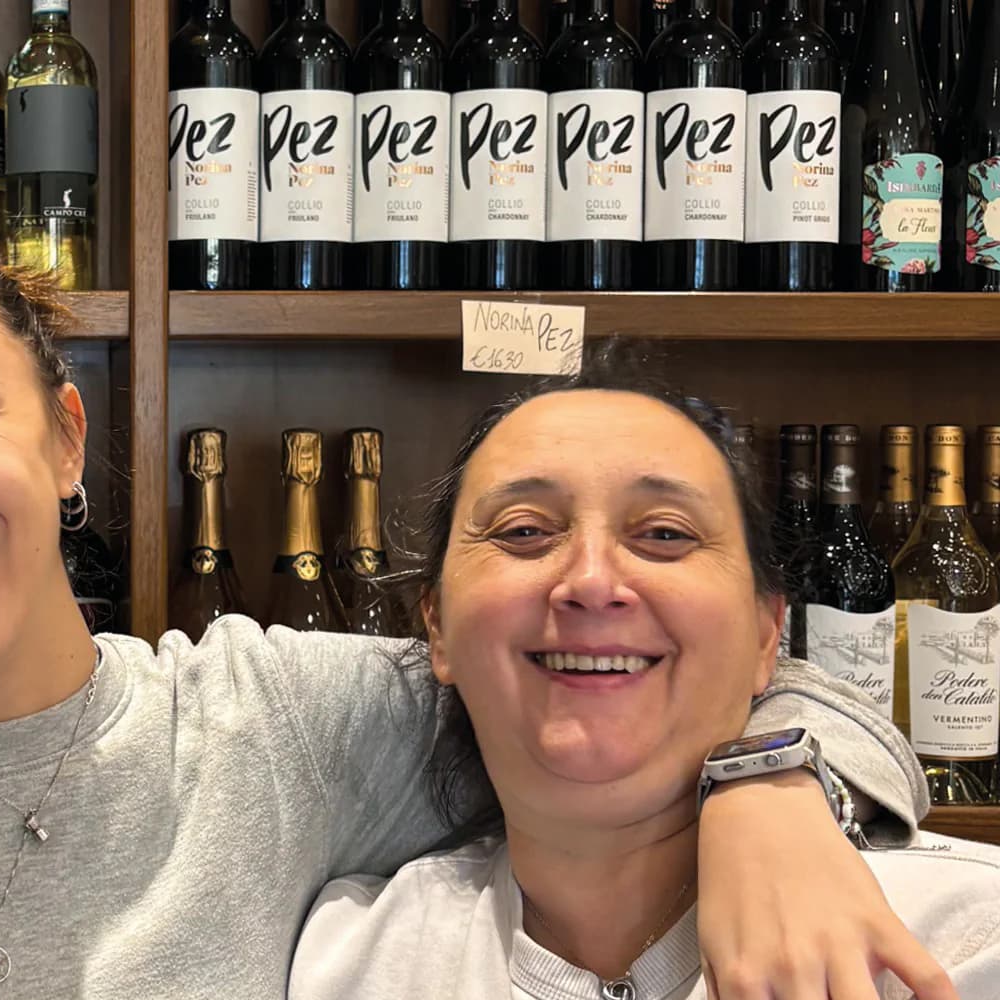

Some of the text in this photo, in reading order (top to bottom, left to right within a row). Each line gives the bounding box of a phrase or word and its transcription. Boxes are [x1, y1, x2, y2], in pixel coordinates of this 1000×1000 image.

[168, 103, 236, 193] Pez
[263, 104, 338, 193] Pez
[361, 104, 437, 193] Pez
[460, 103, 537, 191] Pez
[557, 103, 635, 191] Pez
[656, 102, 735, 191] Pez
[760, 104, 836, 192] Pez
[185, 199, 219, 209] COLLIO
[288, 200, 323, 210] COLLIO
[387, 200, 422, 210] COLLIO
[488, 199, 523, 209] COLLIO
[586, 199, 621, 209] COLLIO
[685, 199, 720, 209] COLLIO
[793, 201, 825, 211] COLLIO
[43, 209, 73, 217] CAMPO
[474, 303, 574, 352] NORINA PEZ
[930, 669, 988, 688] Podere
[921, 690, 942, 700] don
[933, 714, 993, 723] VERMENTINO
